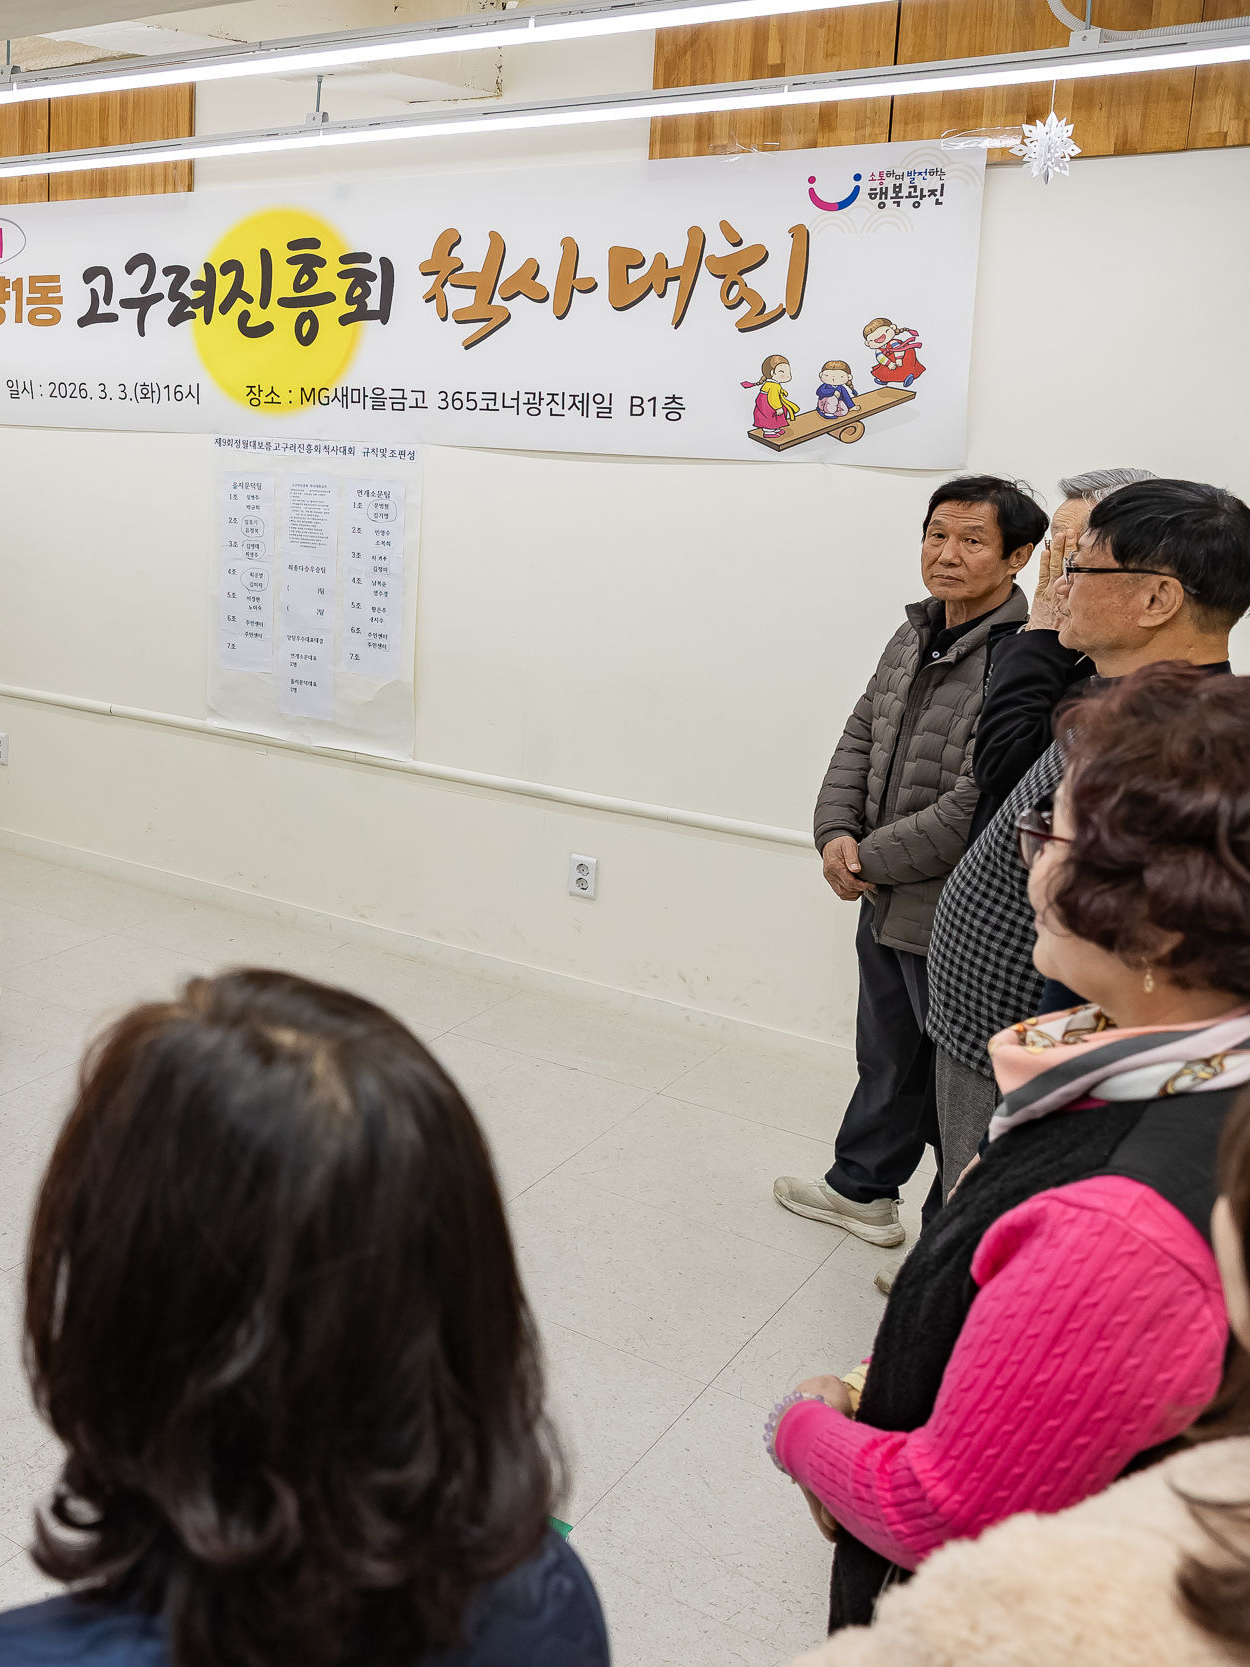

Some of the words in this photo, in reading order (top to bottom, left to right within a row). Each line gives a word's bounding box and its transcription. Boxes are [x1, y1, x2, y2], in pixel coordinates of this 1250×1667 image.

[868, 169, 905, 186] 소통하며
[906, 167, 947, 184] 발전하는
[868, 183, 945, 209] 행복광진
[77, 238, 394, 346] 고구려진흥회
[419, 220, 810, 350] 척사대회
[6, 379, 35, 400] 일시
[48, 382, 93, 401] 2026.
[98, 383, 113, 400] 3.
[120, 382, 200, 405] 3.(화)16시
[246, 385, 281, 406] 장소
[301, 386, 428, 411] MG새마을금고
[438, 391, 612, 419] 365코너광진제일
[630, 394, 686, 421] B1층
[356, 489, 391, 499] 연개소문팀
[352, 577, 363, 585] 4조
[351, 601, 362, 609] 5조
[351, 626, 362, 634] 6조
[349, 653, 361, 661] 7조
